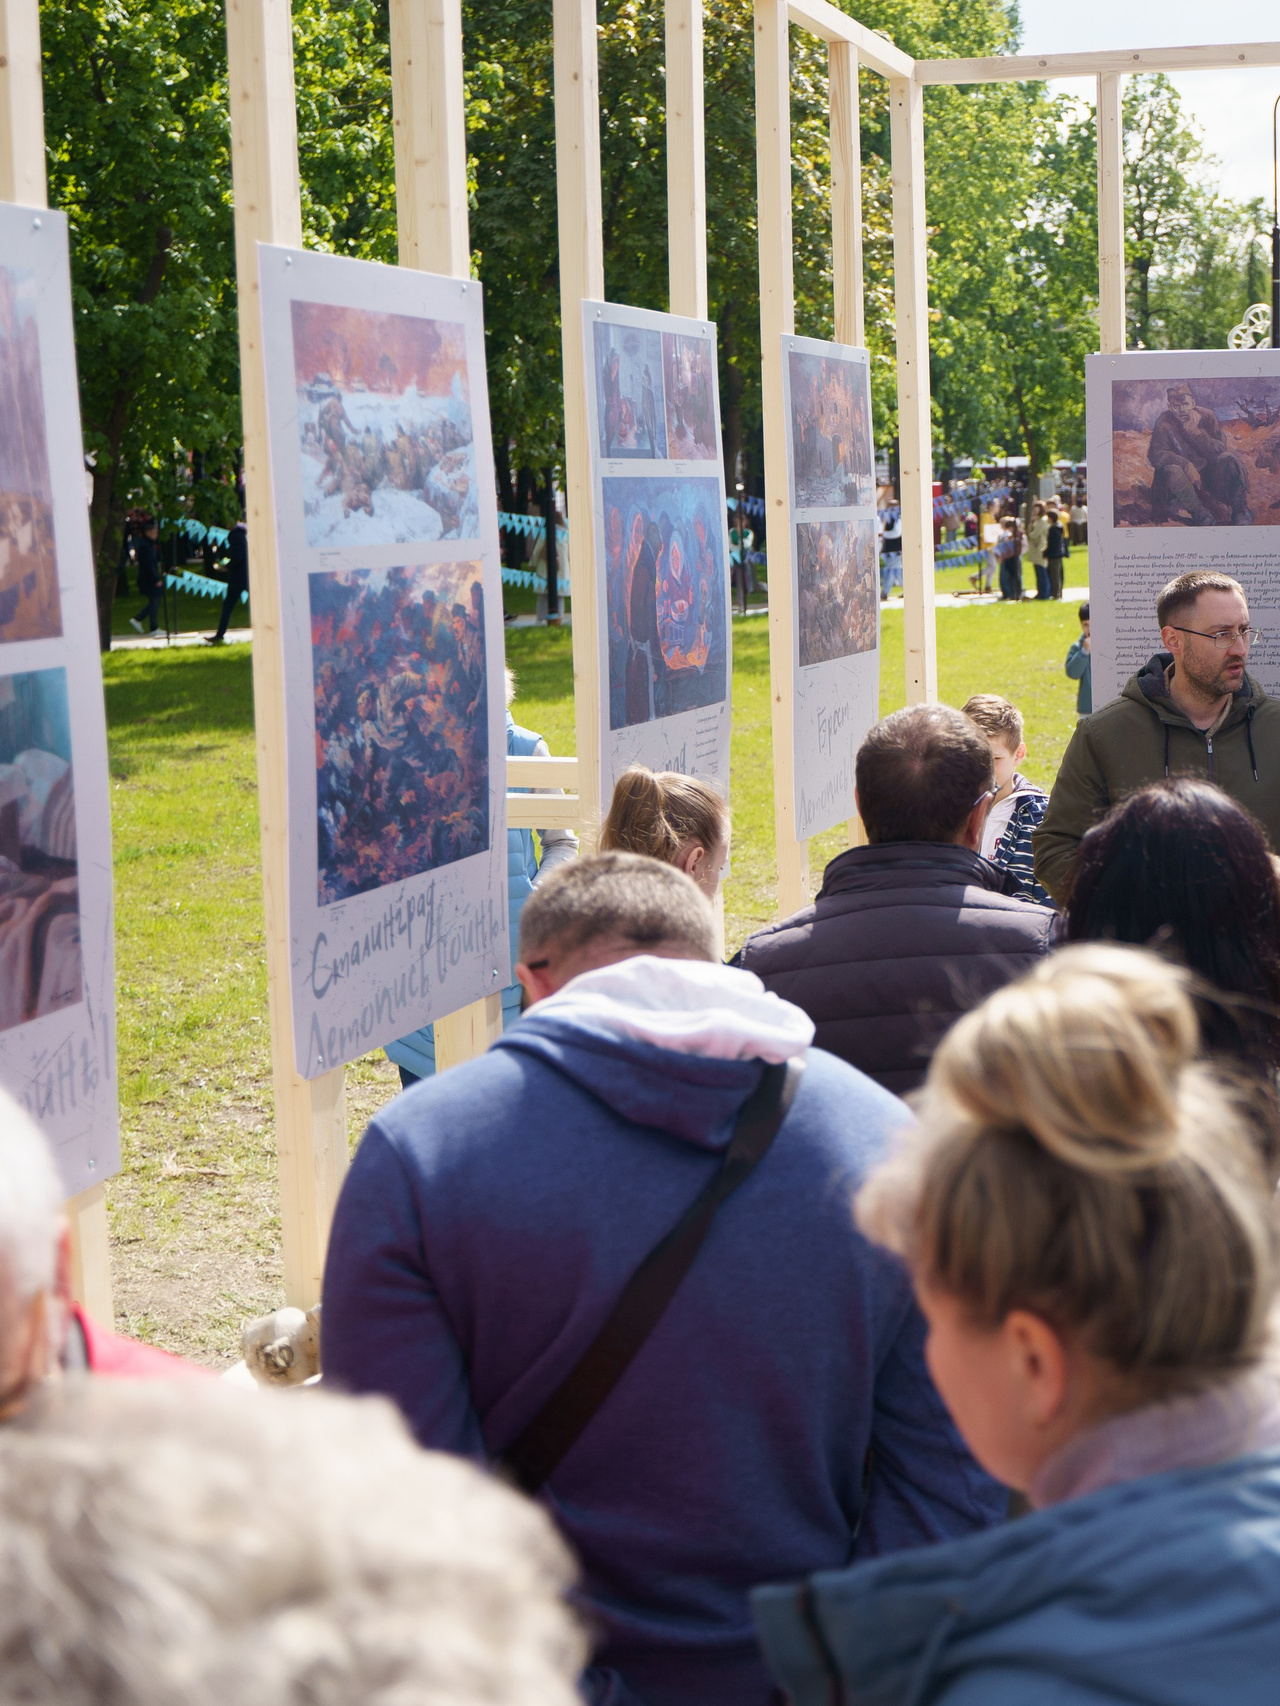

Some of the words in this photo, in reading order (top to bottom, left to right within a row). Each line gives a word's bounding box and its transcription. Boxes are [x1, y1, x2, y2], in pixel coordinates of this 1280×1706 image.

[817, 702, 850, 757] Брест
[304, 943, 430, 1082] Летопись
[436, 880, 506, 985] войны
[312, 878, 436, 1000] Сталинград
